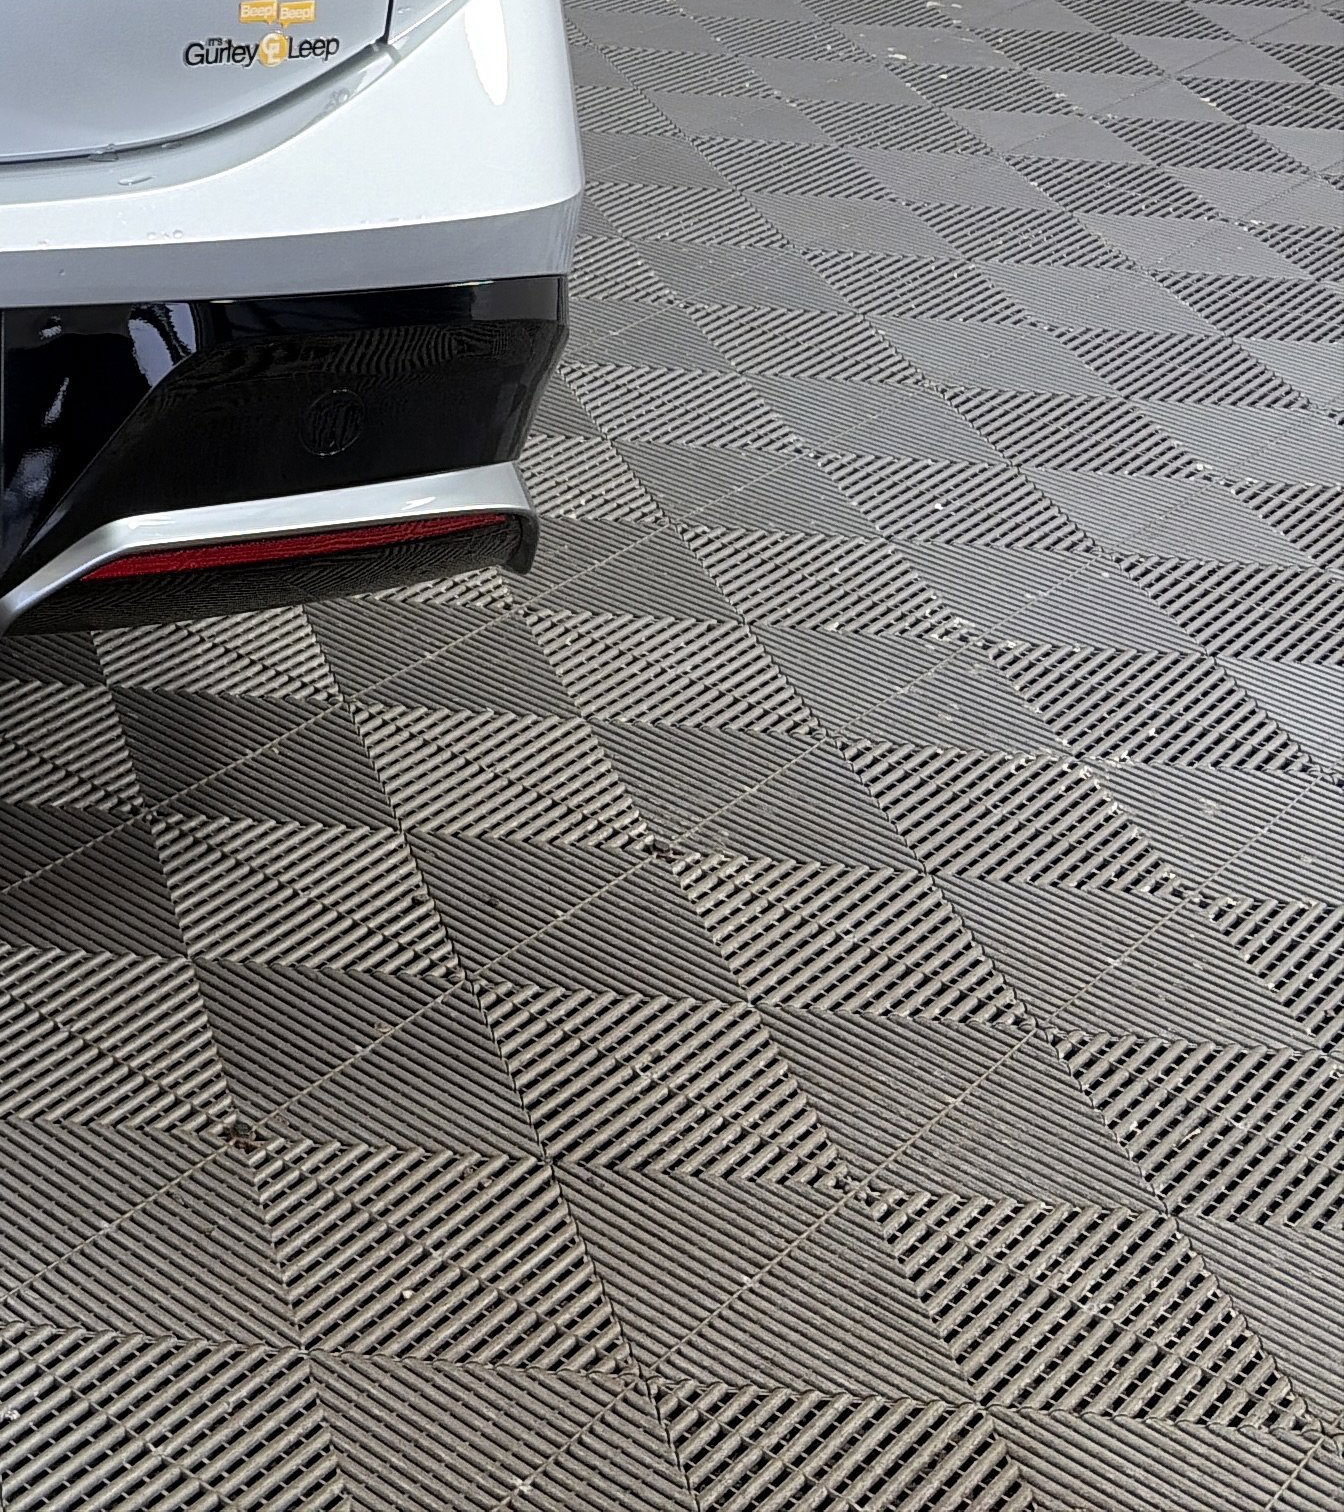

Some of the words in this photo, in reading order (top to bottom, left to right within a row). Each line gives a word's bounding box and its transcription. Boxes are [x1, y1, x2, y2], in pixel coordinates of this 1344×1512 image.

[240, 4, 278, 19] Beep!
[280, 6, 314, 20] Beep!
[184, 38, 260, 68] Gurley
[288, 36, 341, 62] Leep
